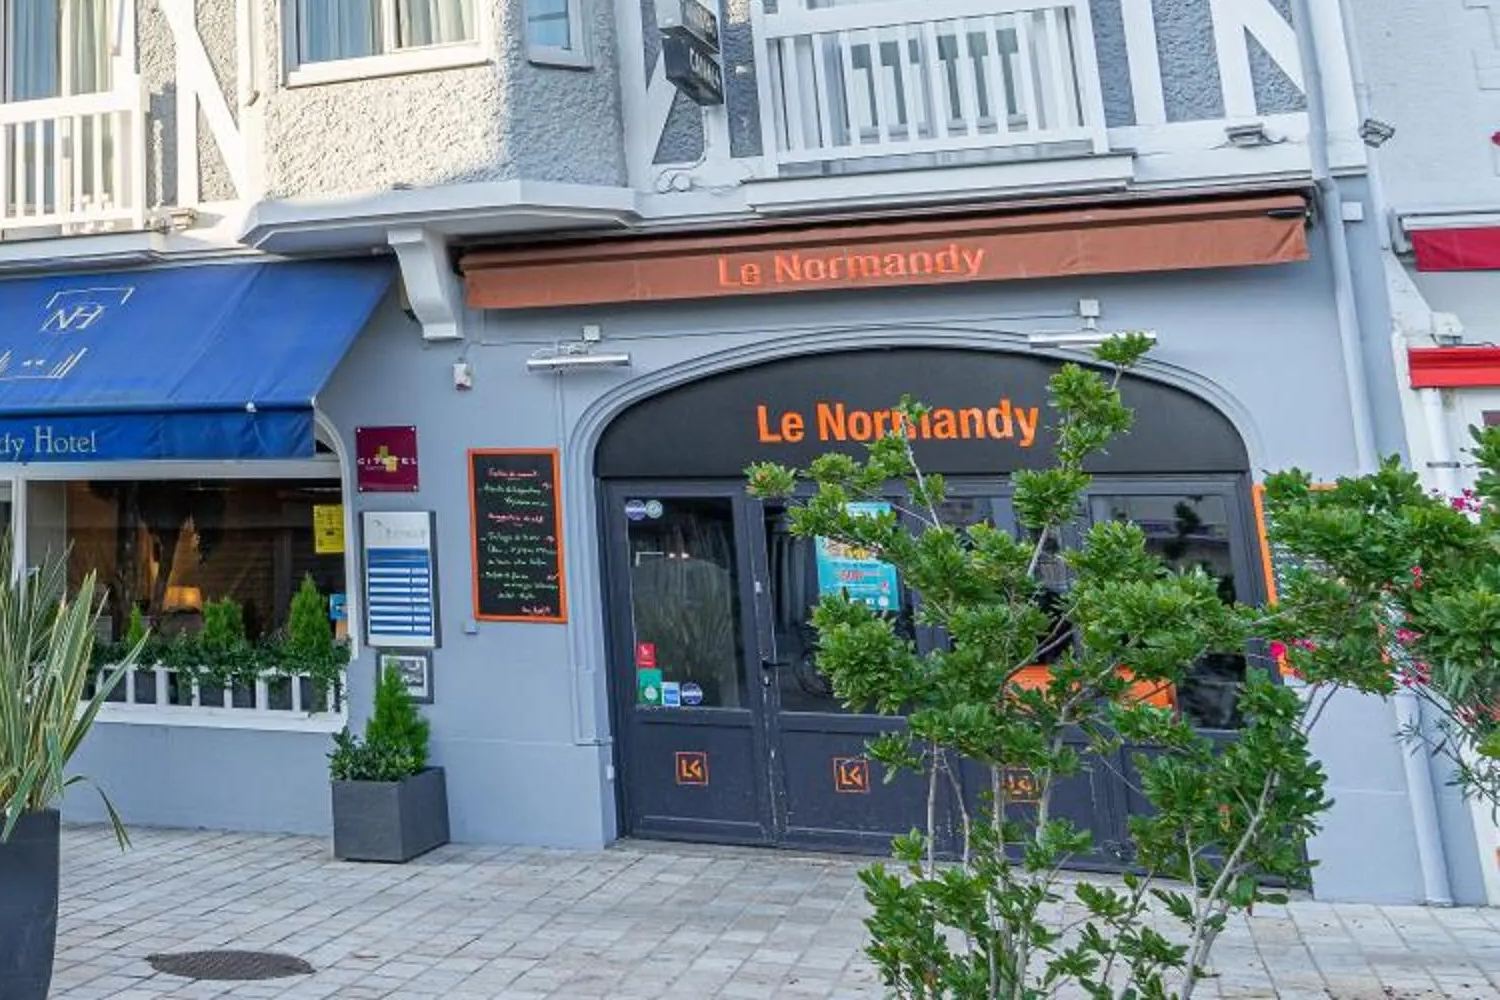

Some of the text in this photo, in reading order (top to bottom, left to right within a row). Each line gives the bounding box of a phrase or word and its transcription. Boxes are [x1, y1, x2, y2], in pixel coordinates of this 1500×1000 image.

[718, 243, 985, 286] Le Normandy
[34, 425, 97, 454] Hotel
[757, 404, 804, 443] Le
